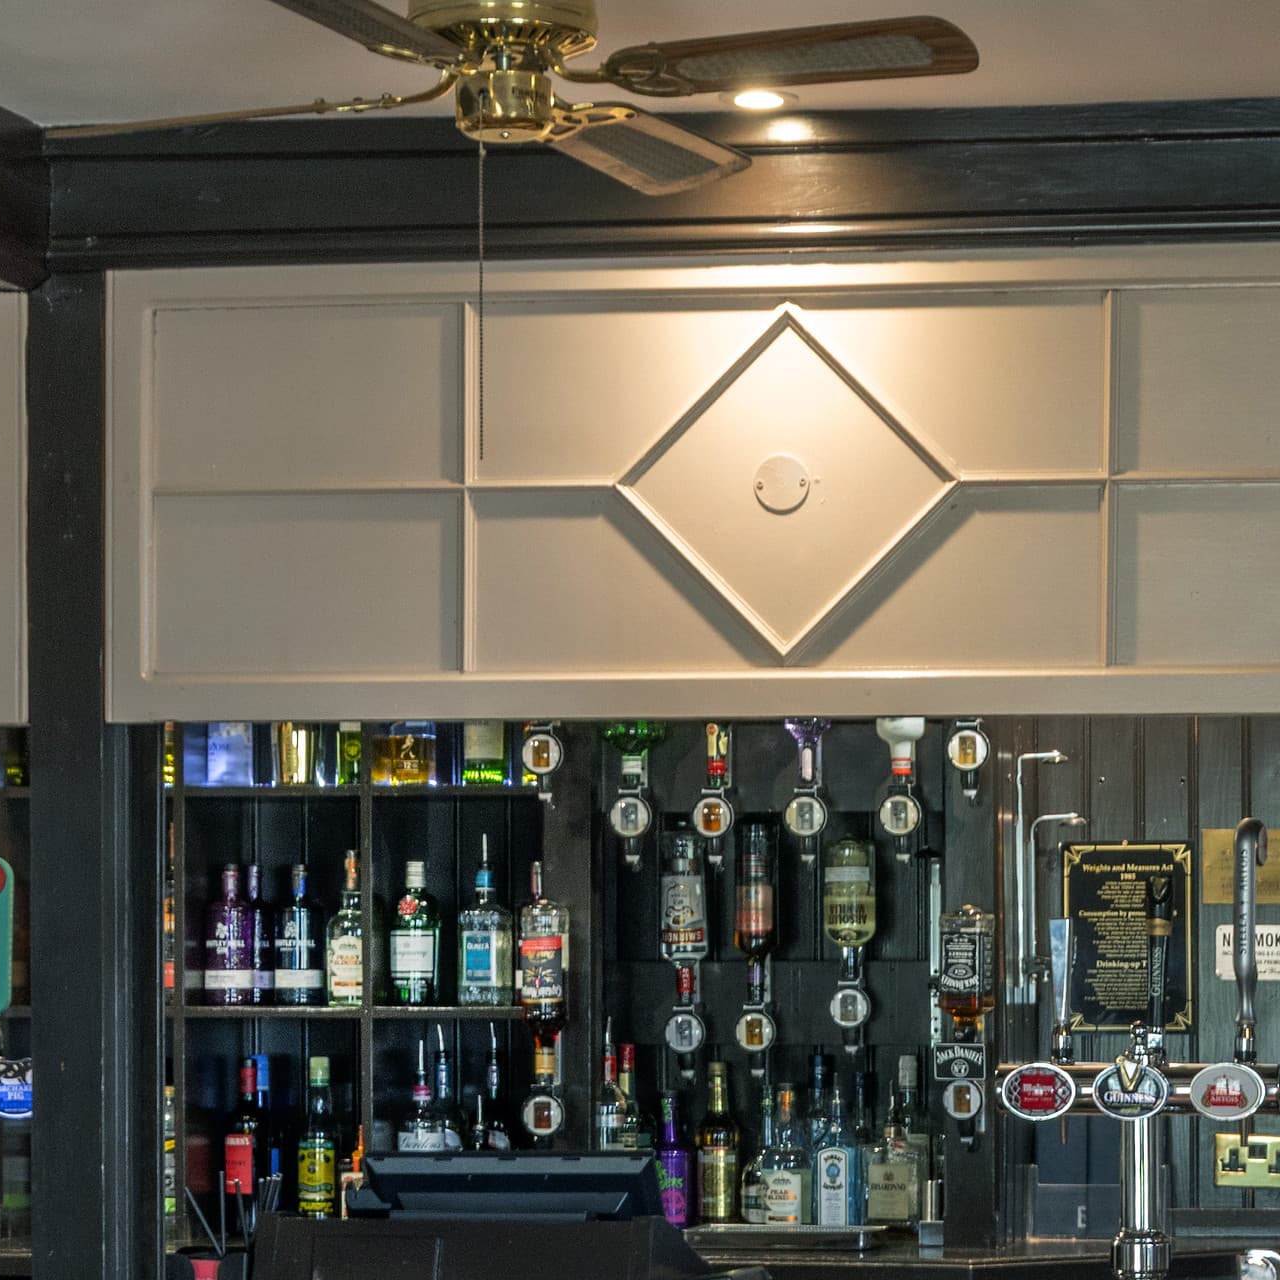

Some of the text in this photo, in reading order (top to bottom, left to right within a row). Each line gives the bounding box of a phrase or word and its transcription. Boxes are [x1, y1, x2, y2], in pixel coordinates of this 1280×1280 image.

[1082, 863, 1174, 874] Weights and Measures Act
[1222, 932, 1232, 947] N
[1150, 946, 1162, 996] GUINNESS
[936, 1047, 955, 1064] JACK
[8, 1091, 25, 1100] PIG
[1104, 1091, 1156, 1104] GUINNESS
